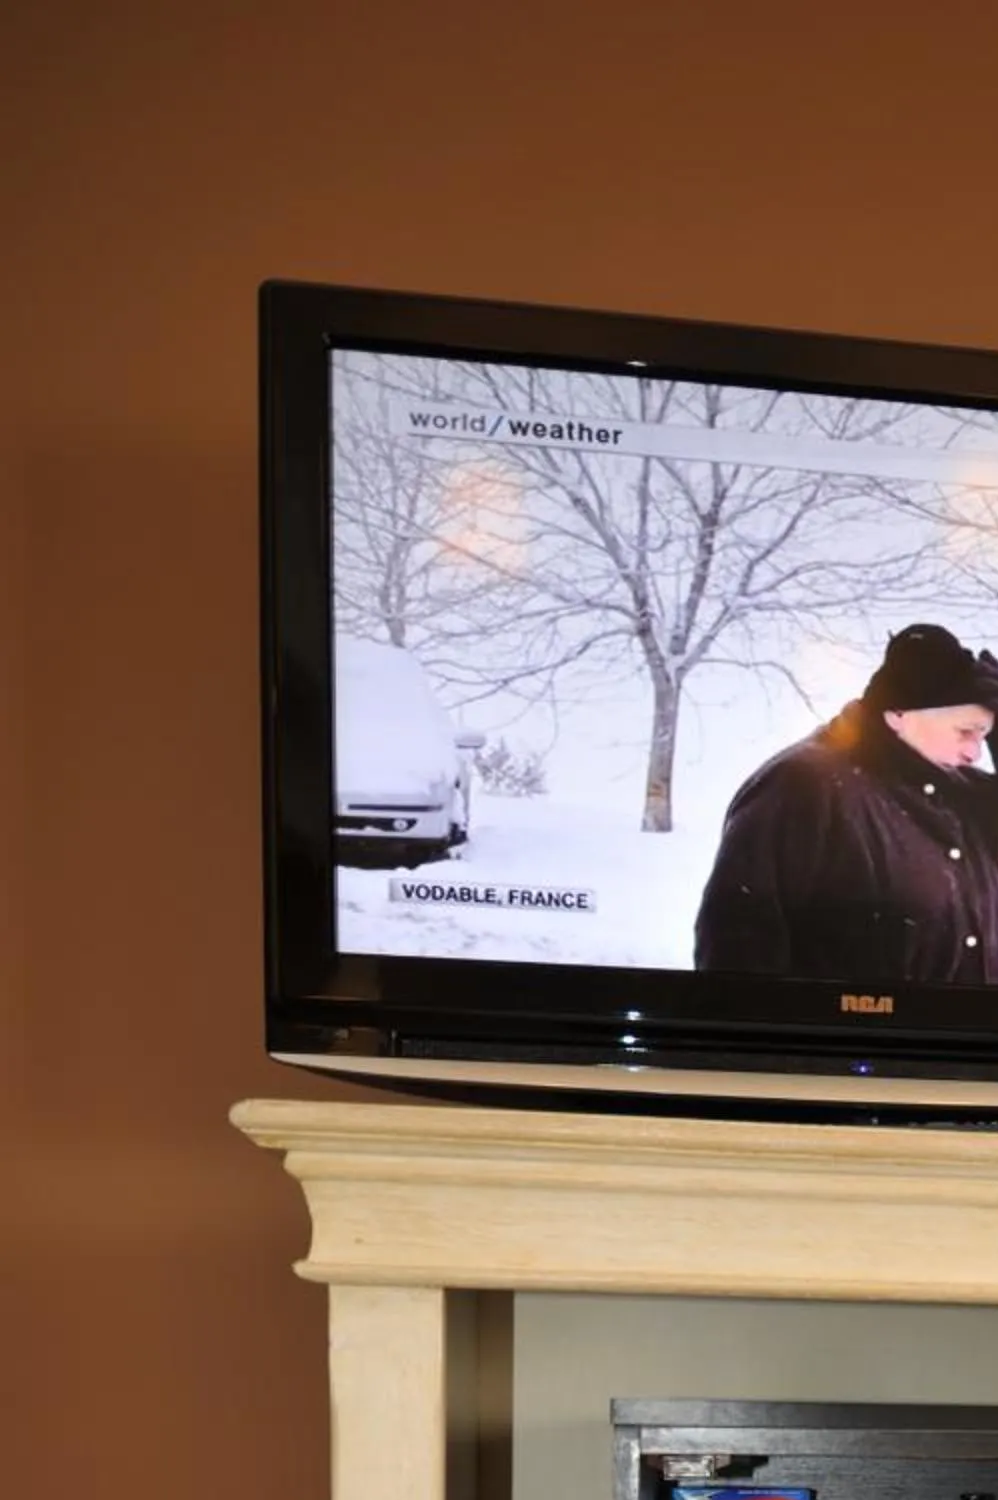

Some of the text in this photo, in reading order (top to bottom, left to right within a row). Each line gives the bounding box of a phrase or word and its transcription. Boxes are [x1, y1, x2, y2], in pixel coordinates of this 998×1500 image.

[402, 883, 589, 908] VODABLE, FRANCE
[841, 994, 893, 1013] RCA
